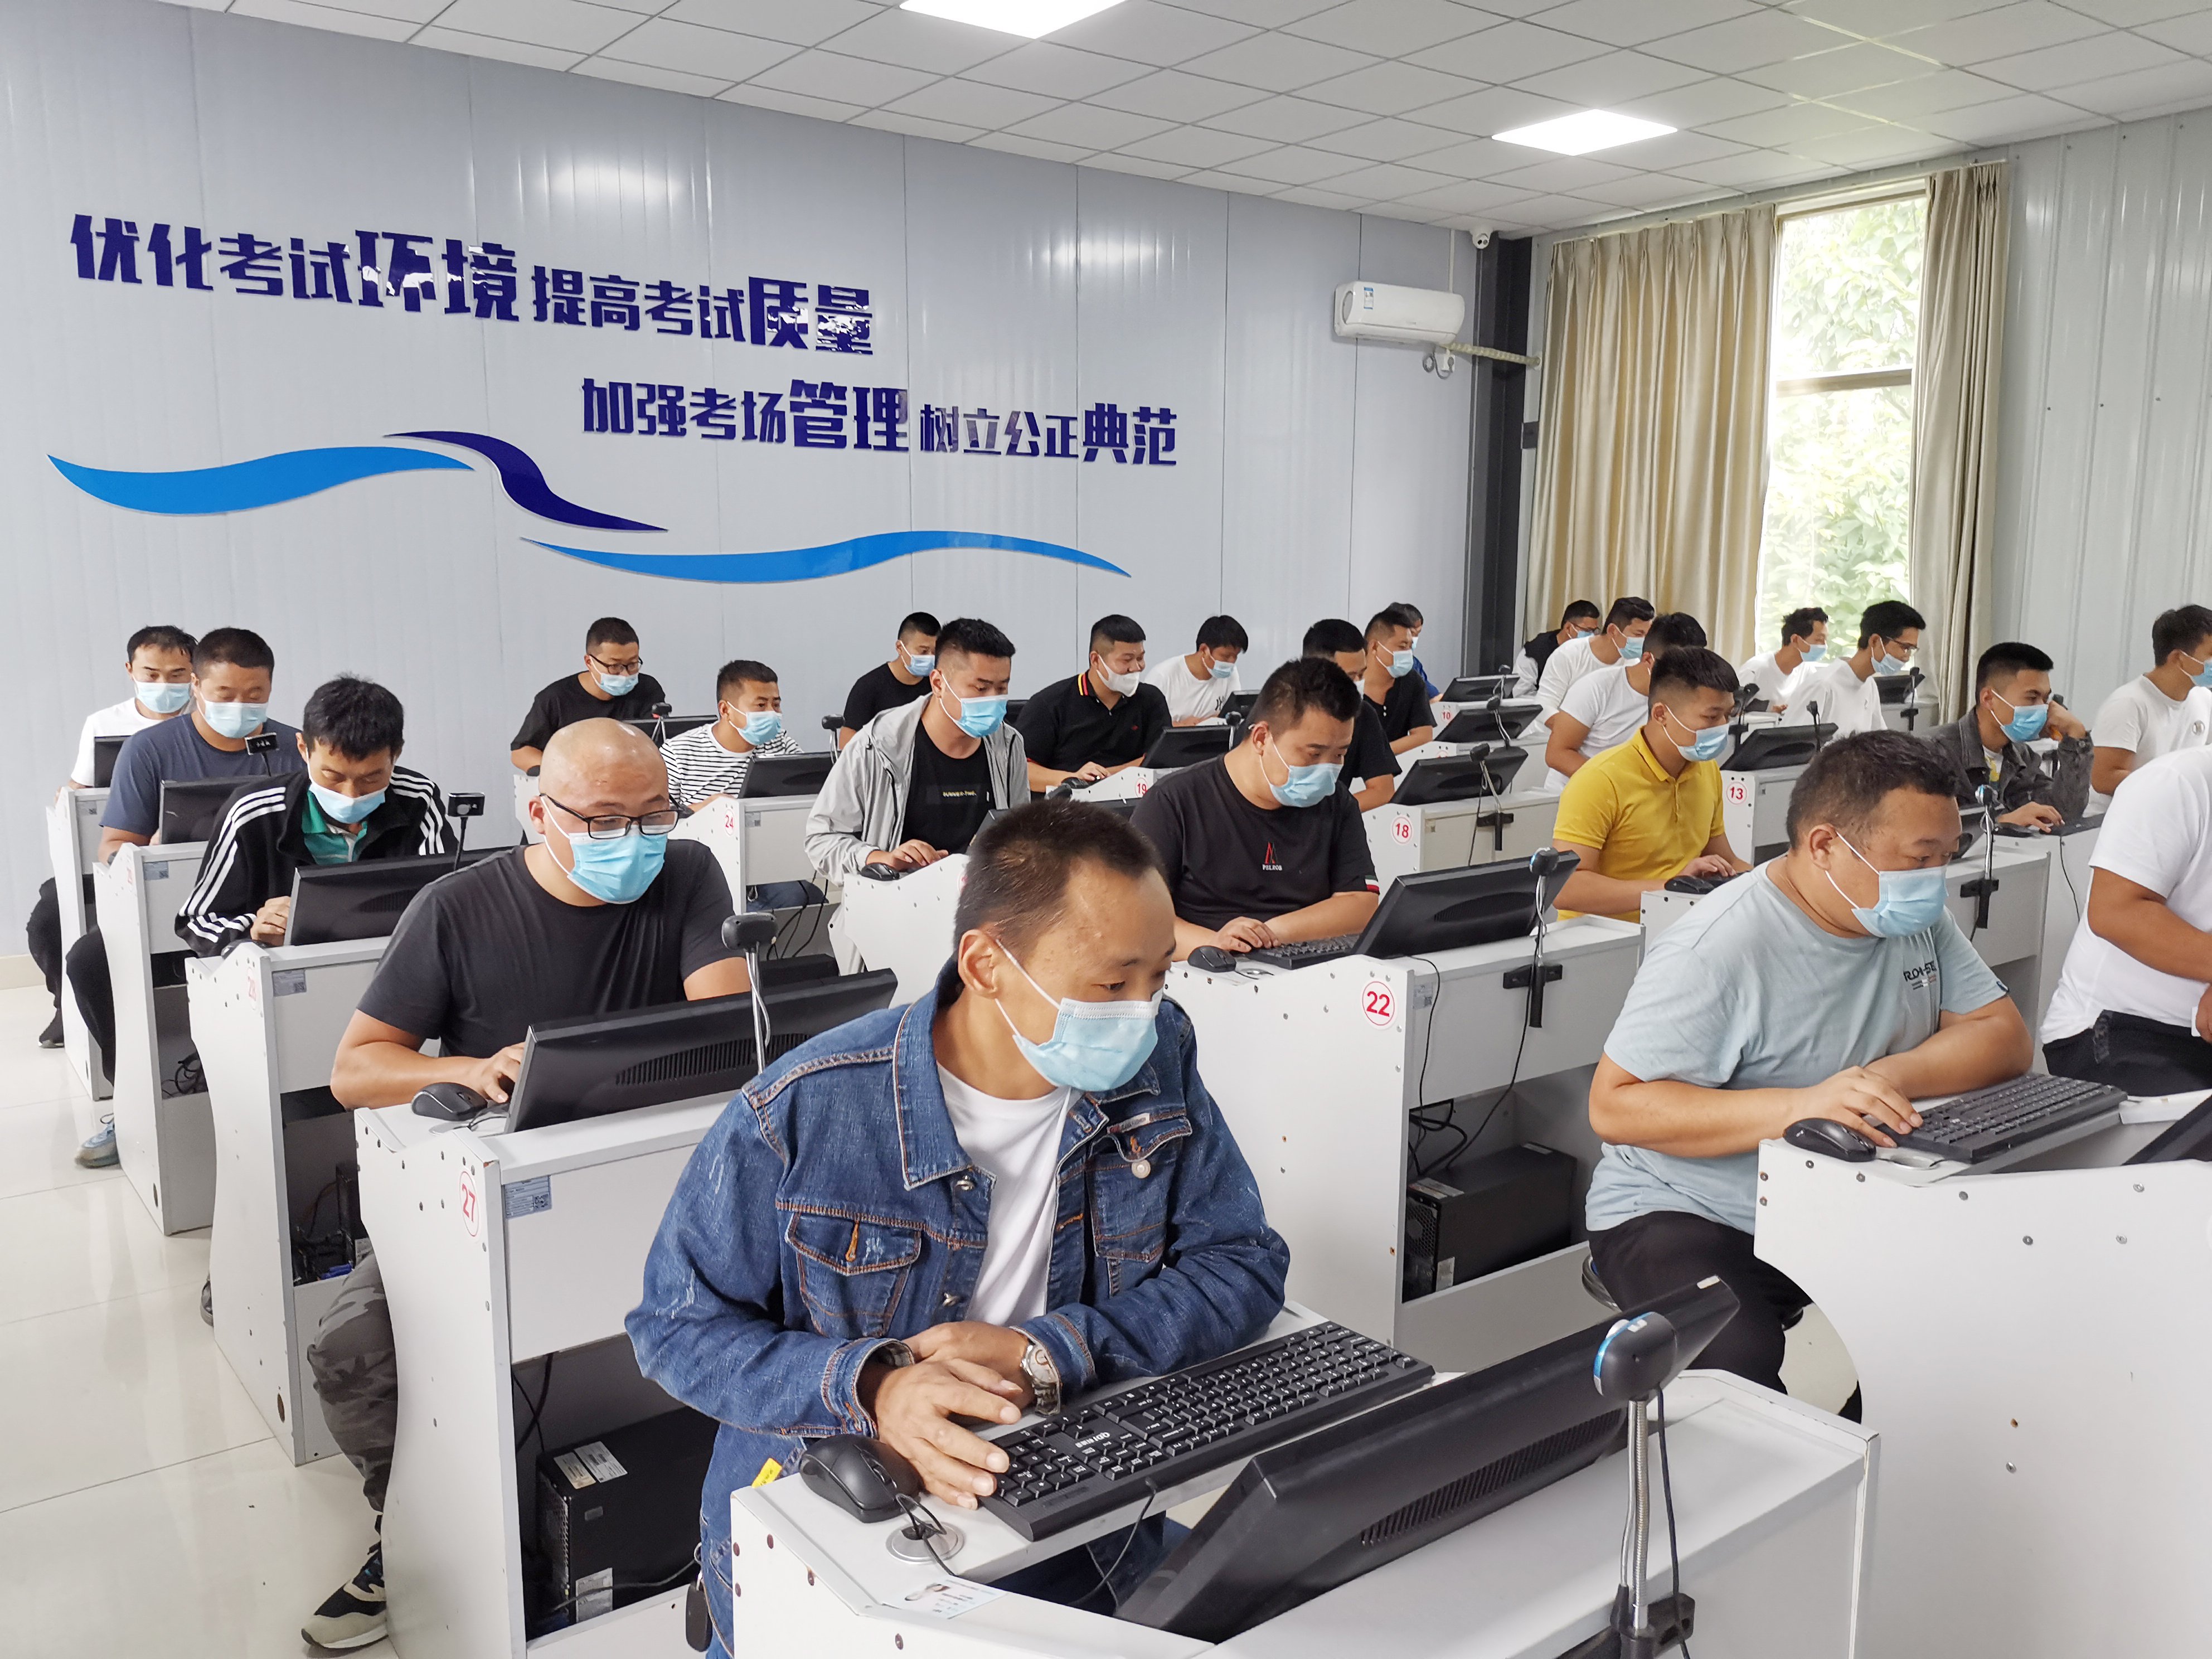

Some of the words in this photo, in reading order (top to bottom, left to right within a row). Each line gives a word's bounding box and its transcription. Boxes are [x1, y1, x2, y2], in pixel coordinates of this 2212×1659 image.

[581, 377, 909, 452] 加强考场管理
[920, 402, 1177, 465] 树立公正典范
[1138, 783, 1148, 795] 19
[1730, 787, 1743, 800] 13
[725, 814, 734, 828] 24
[1396, 823, 1409, 838] 18
[1366, 991, 1390, 1017] 22
[462, 1183, 476, 1223] 27
